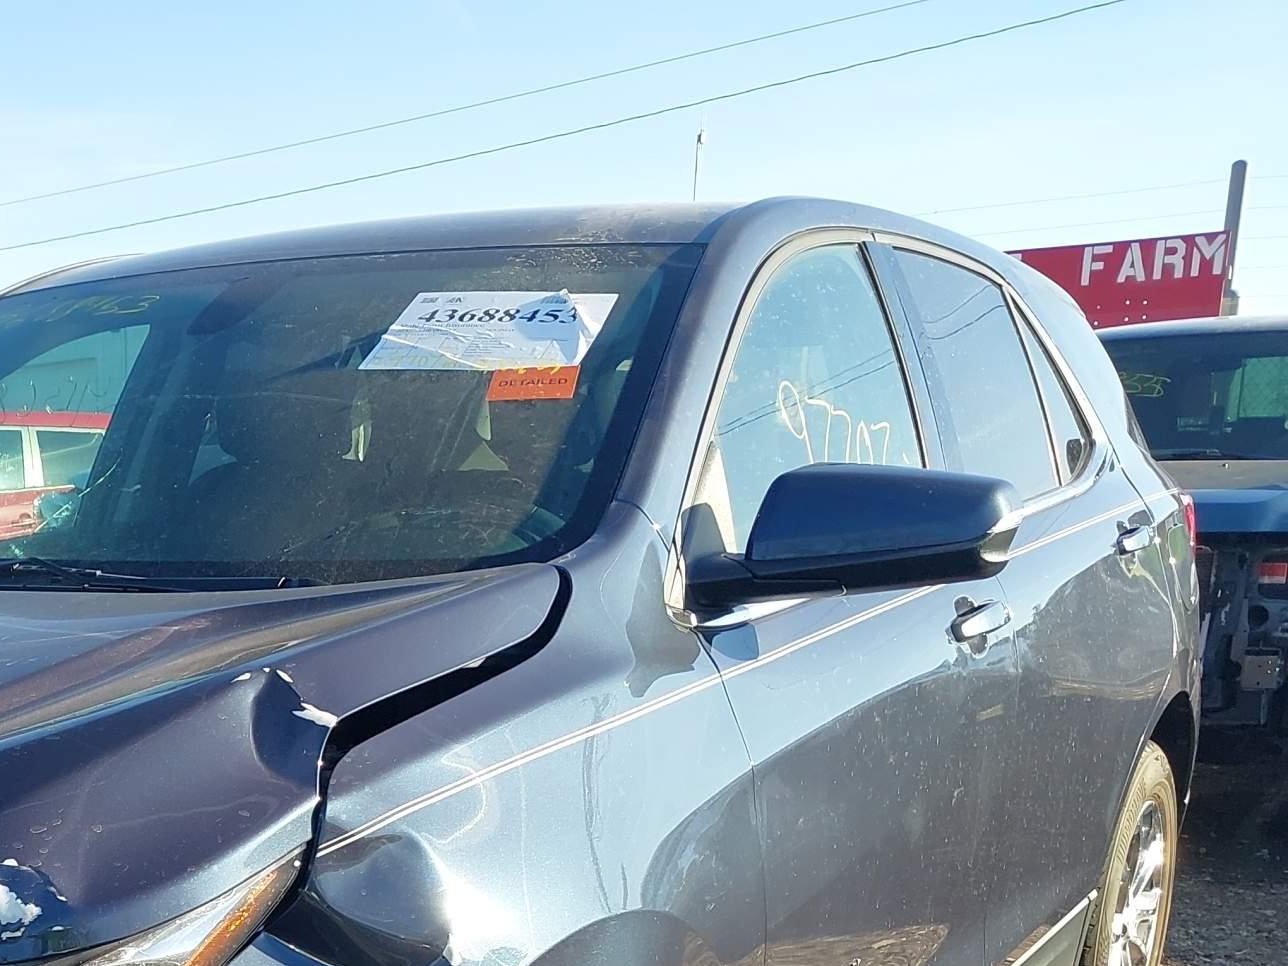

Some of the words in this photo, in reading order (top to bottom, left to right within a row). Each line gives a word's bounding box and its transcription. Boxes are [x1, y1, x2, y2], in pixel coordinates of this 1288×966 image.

[1080, 233, 1228, 286] FARM
[417, 306, 578, 325] 43688453
[498, 377, 568, 388] DETAILED
